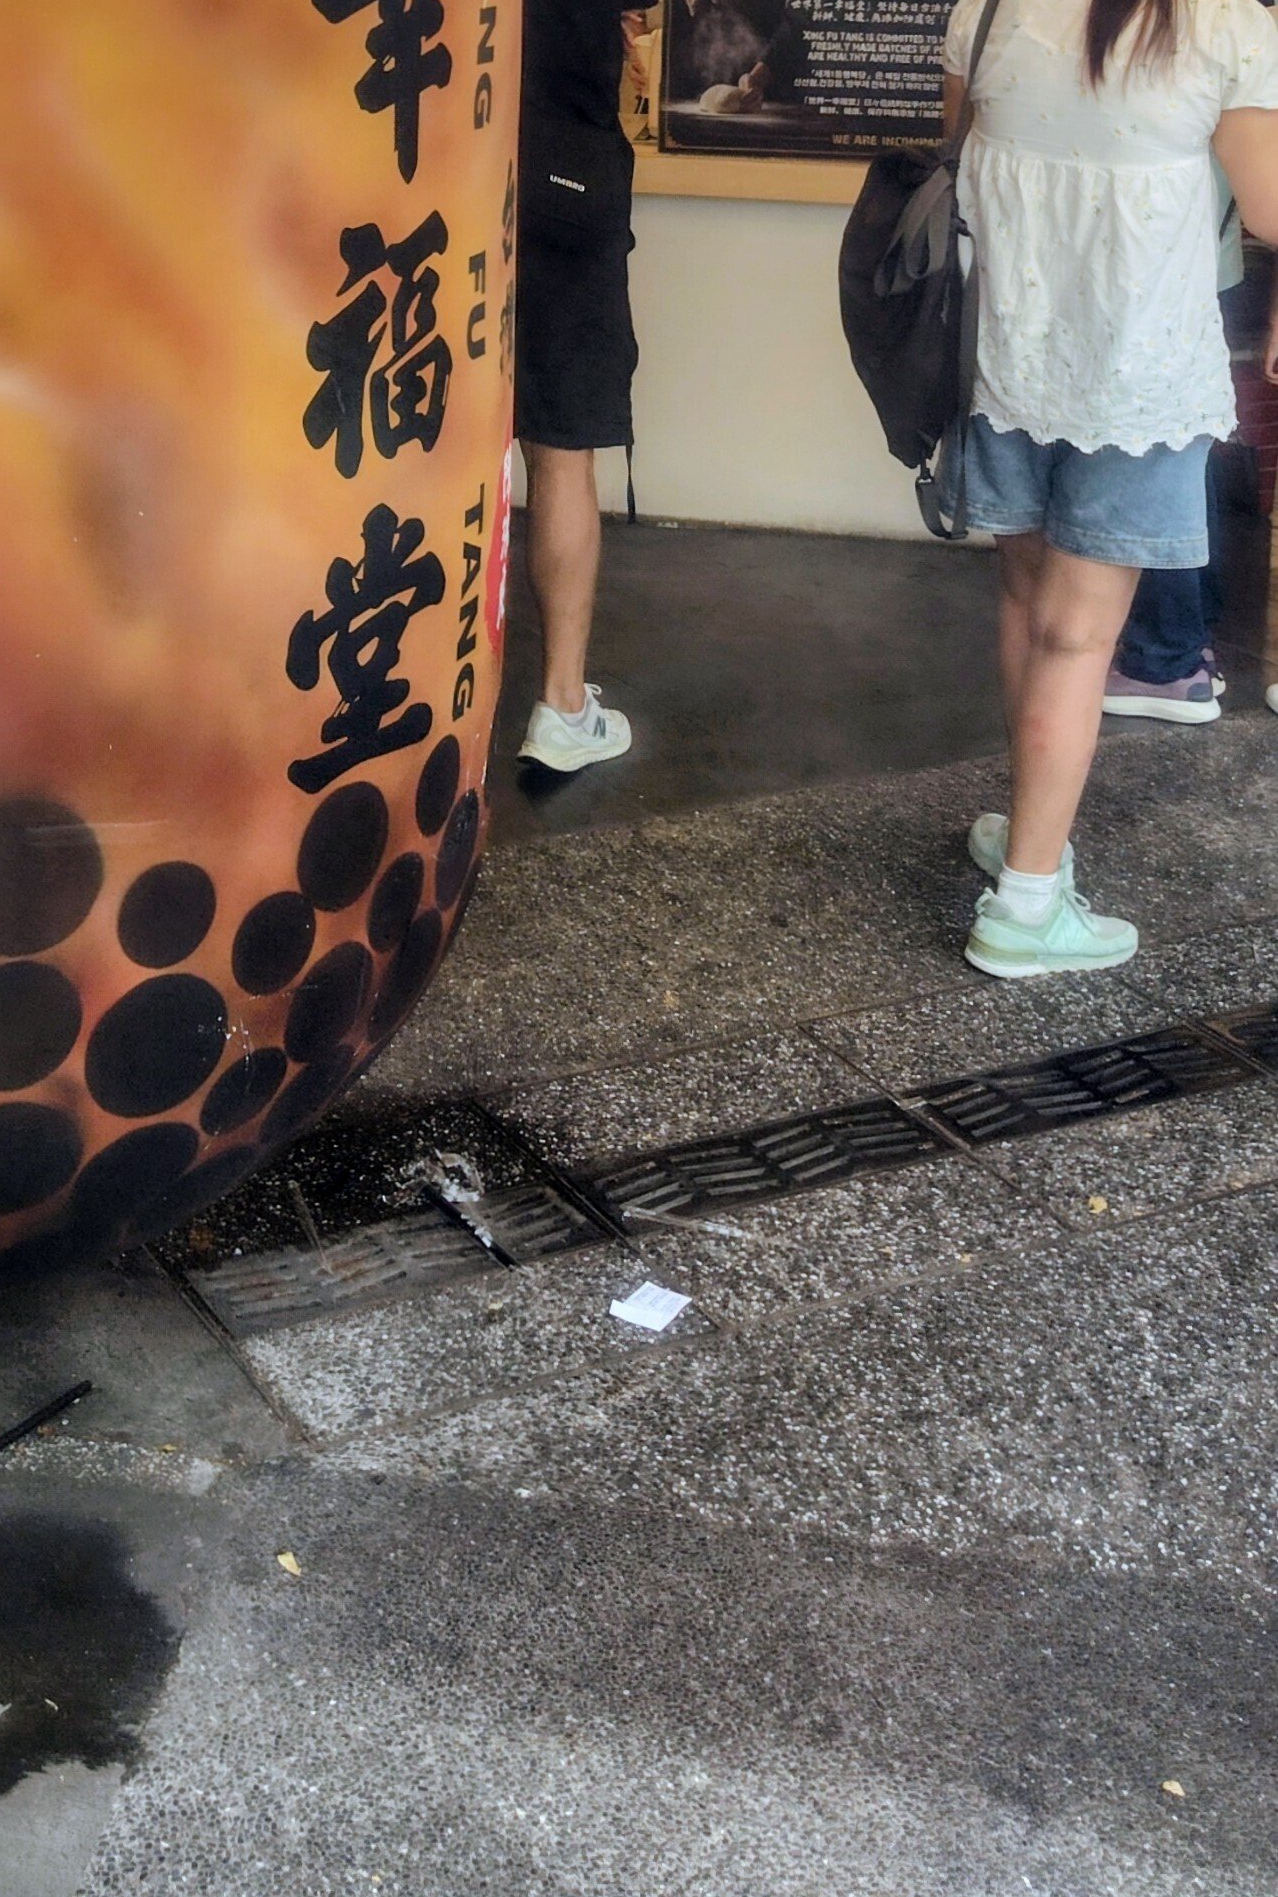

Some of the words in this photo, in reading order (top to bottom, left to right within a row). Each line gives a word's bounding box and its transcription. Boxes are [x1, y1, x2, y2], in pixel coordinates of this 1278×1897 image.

[832, 134, 851, 146] WE
[853, 135, 878, 146] ARE
[549, 174, 585, 193] UMBRO
[466, 249, 486, 361] FU
[451, 482, 486, 723] TANG
